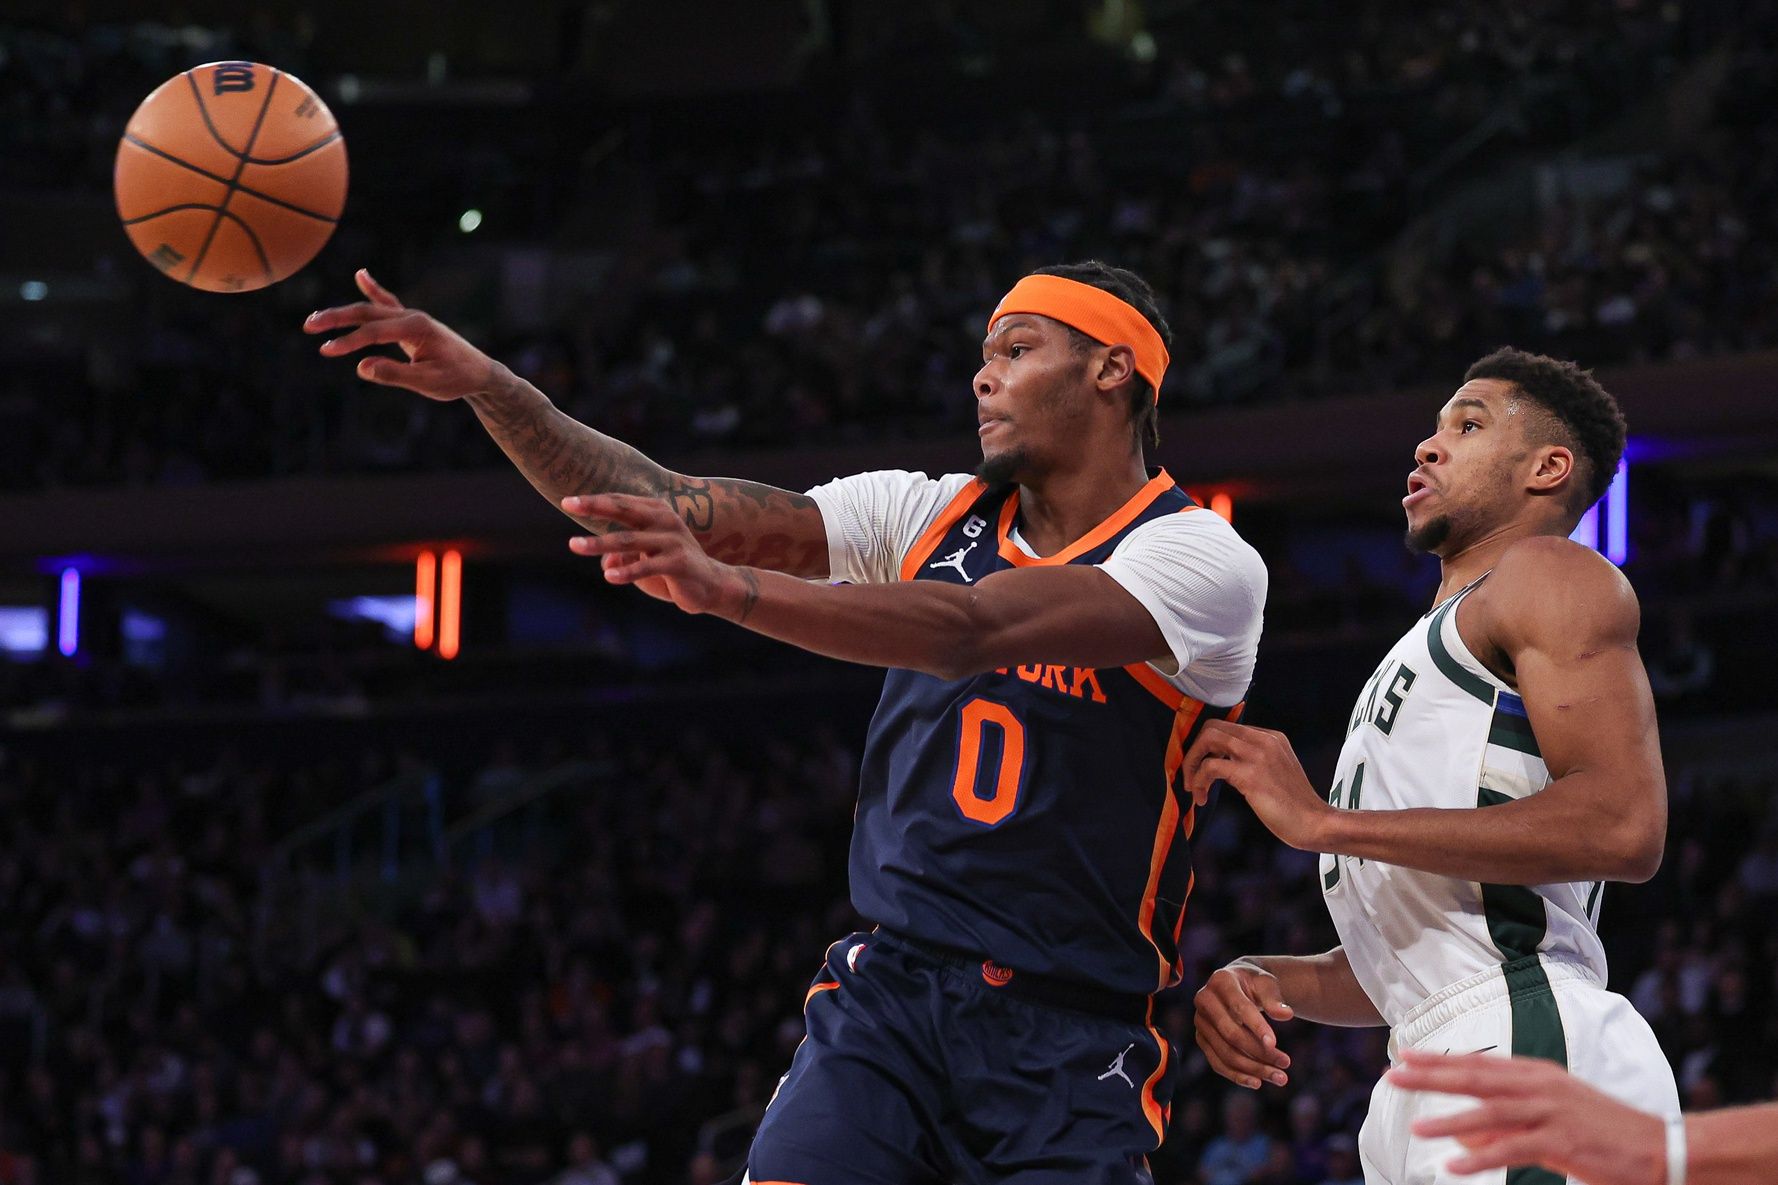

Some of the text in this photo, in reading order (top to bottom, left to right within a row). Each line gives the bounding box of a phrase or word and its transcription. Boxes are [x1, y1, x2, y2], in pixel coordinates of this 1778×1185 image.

[962, 514, 987, 538] 6
[994, 663, 1107, 704] ORK
[951, 697, 1025, 827] 0
